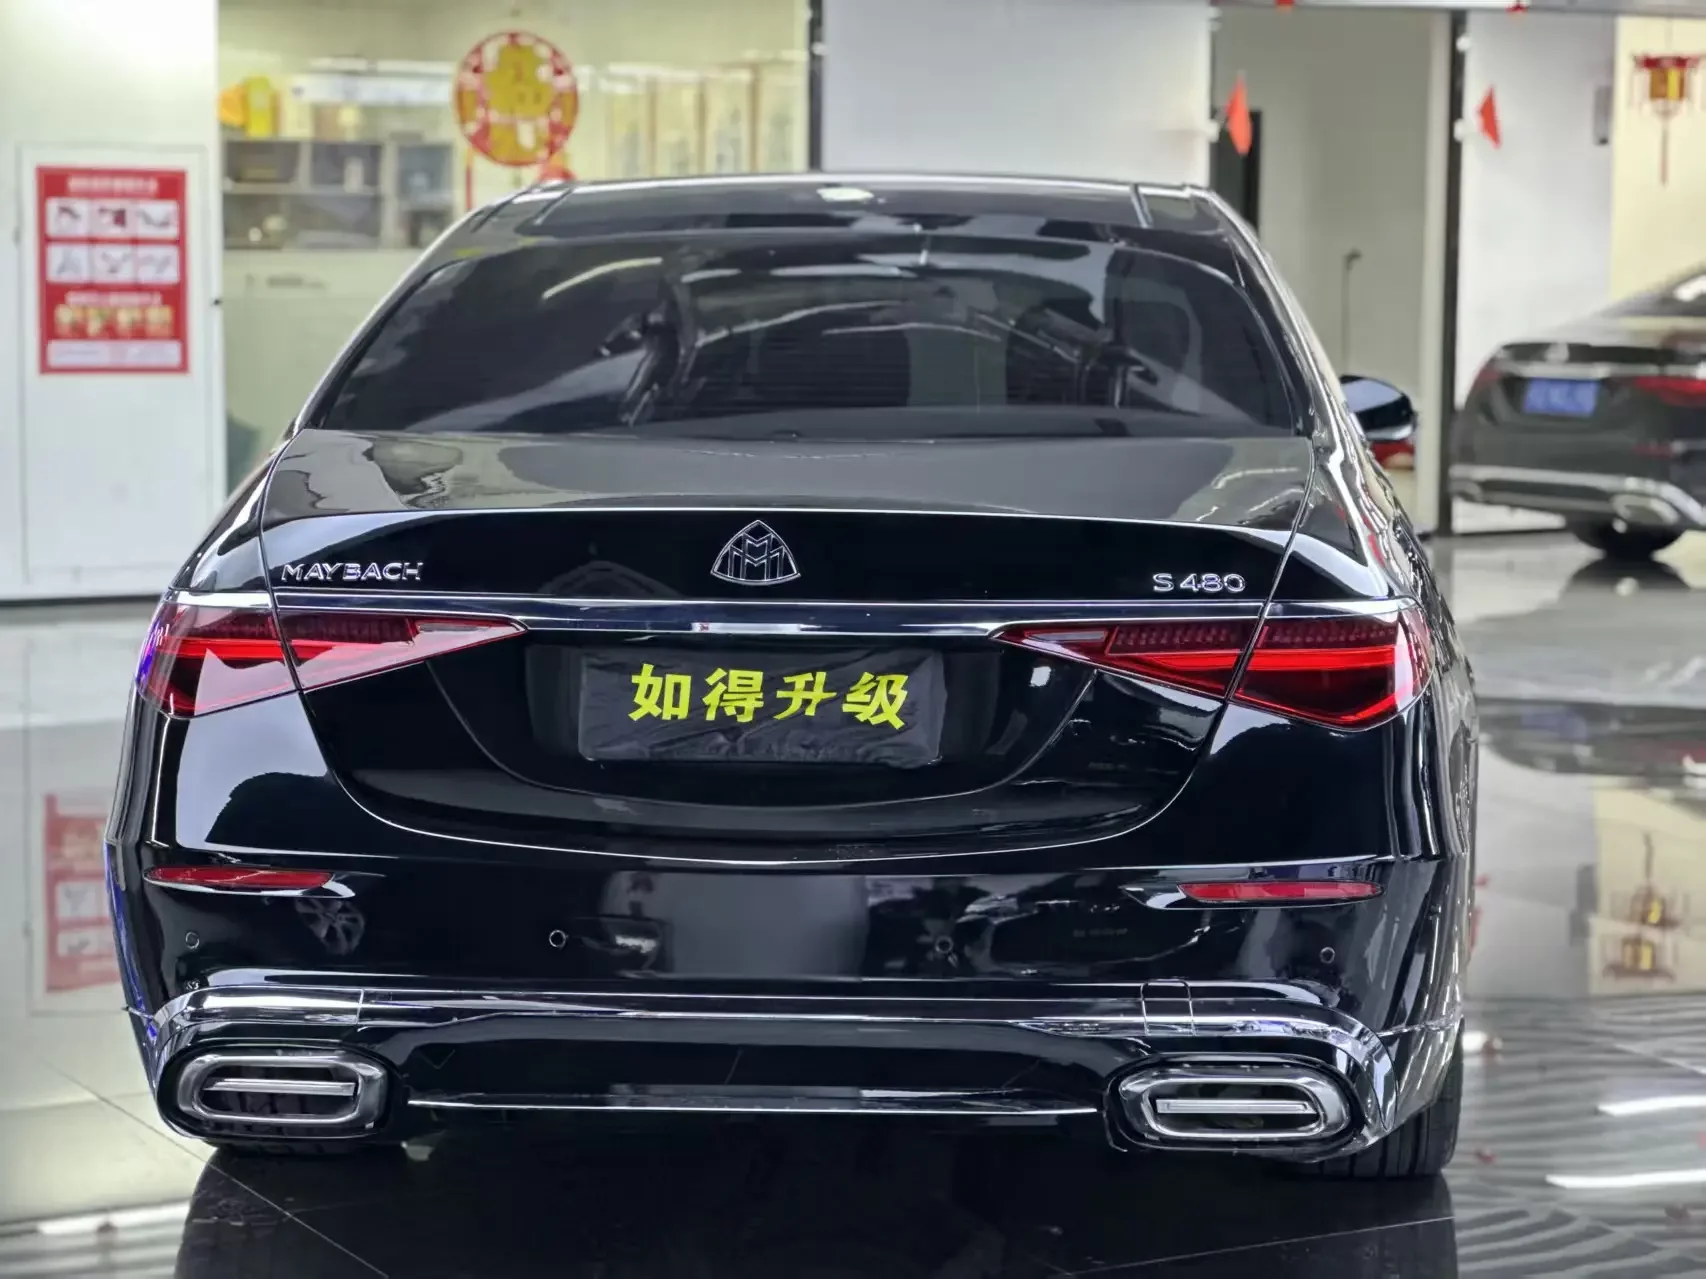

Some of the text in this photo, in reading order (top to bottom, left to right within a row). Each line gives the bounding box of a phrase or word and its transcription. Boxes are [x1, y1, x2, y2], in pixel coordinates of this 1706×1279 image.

[280, 562, 424, 582] MAYBACH
[1152, 573, 1246, 593] S 480
[628, 663, 909, 730] 如得升级
